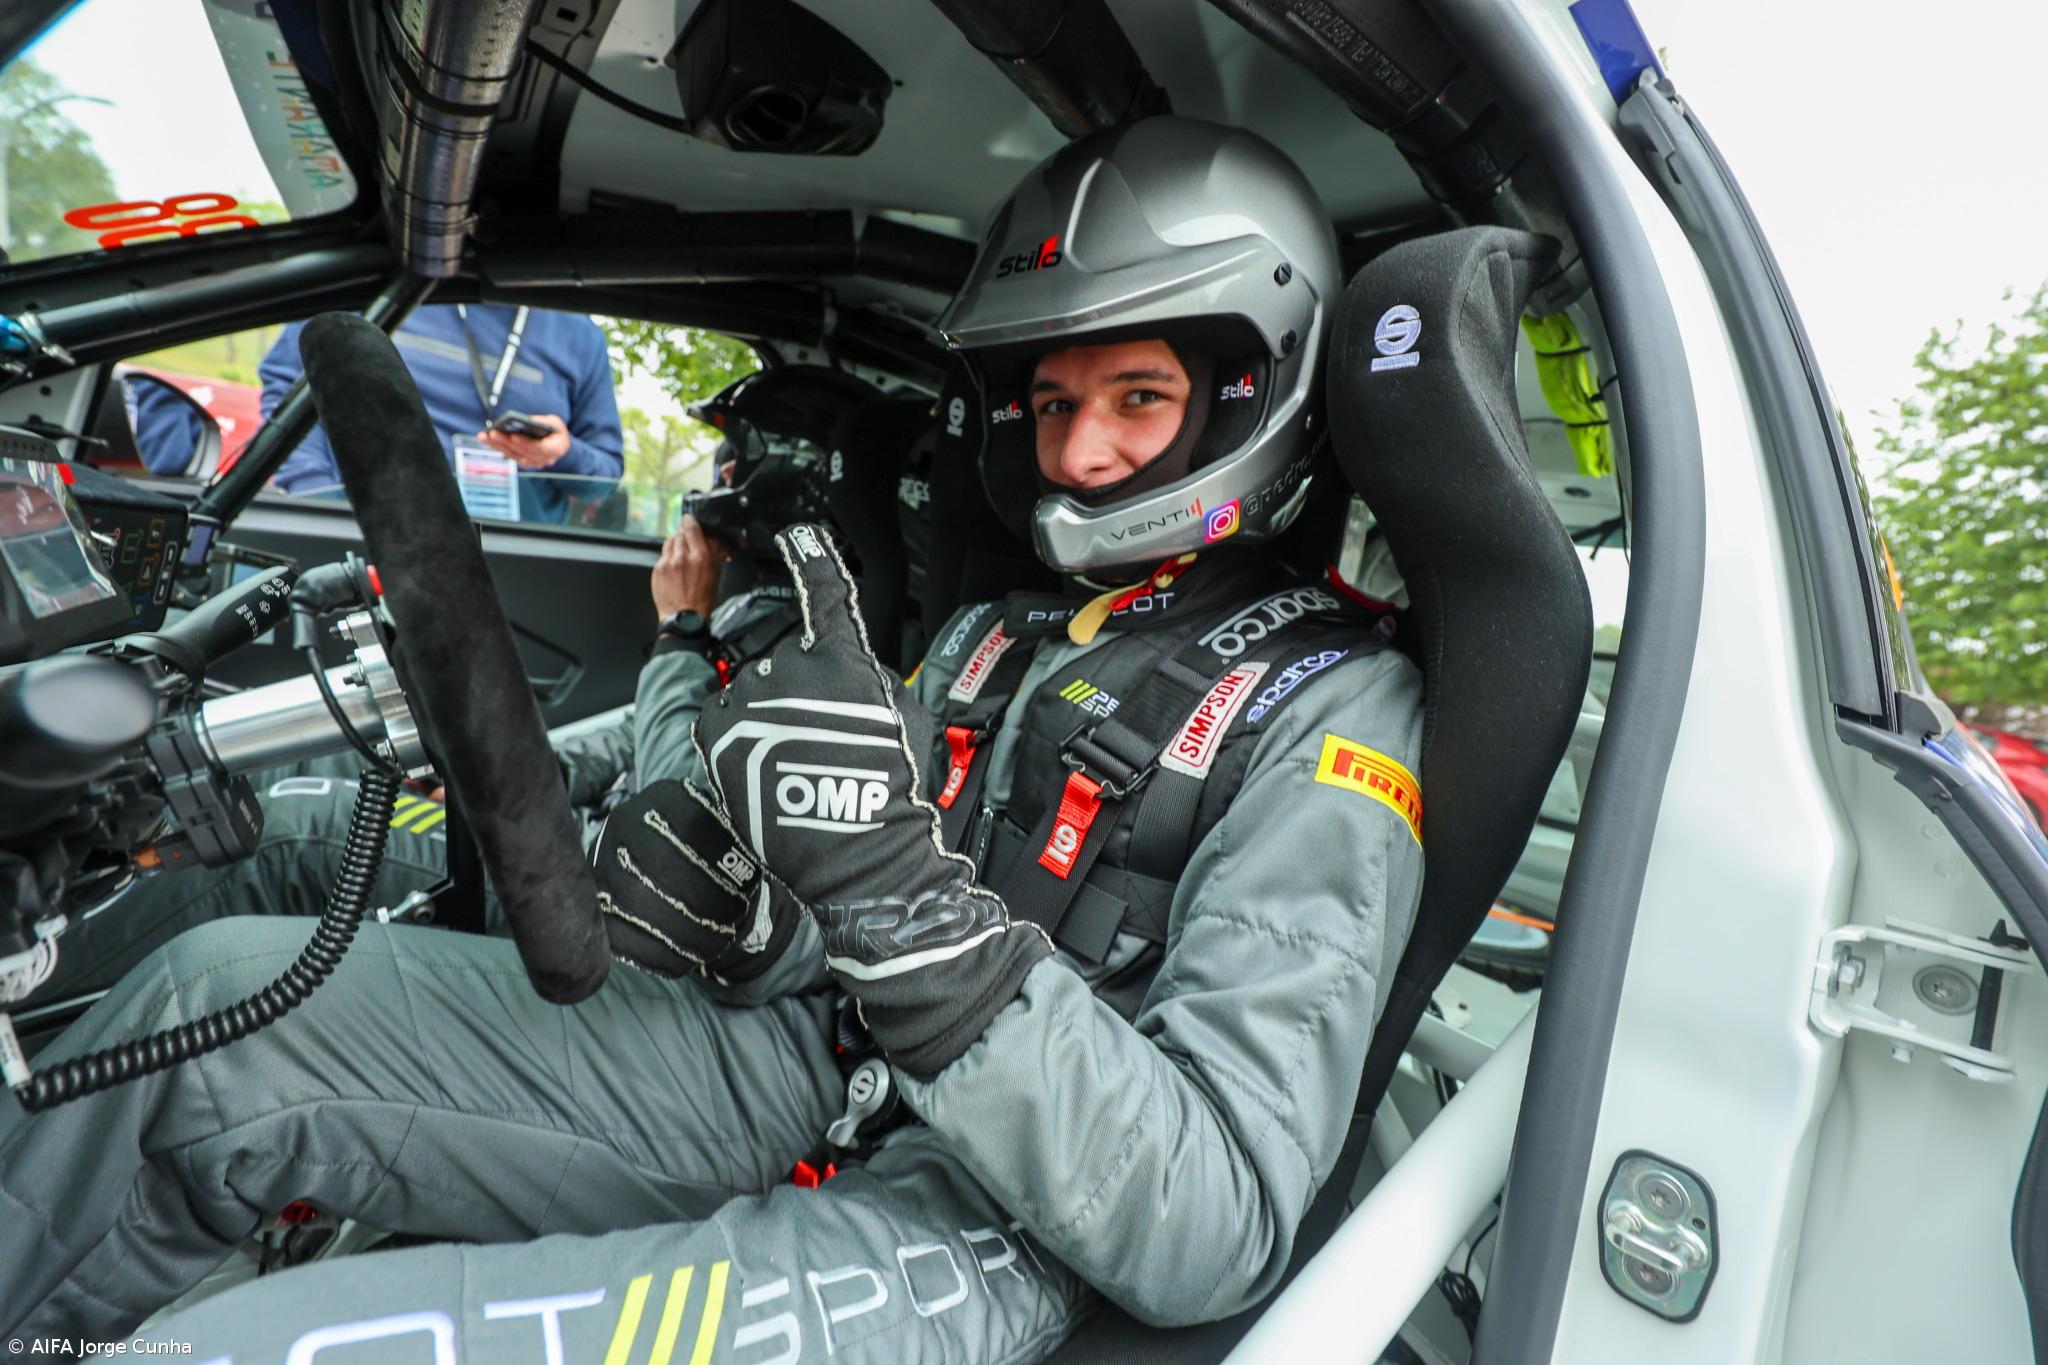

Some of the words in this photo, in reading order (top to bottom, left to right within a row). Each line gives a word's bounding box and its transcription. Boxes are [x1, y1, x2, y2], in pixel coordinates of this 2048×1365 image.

[1027, 592, 1175, 623] PEOT
[1205, 587, 1342, 657] sparco
[1179, 668, 1245, 759] SIMPSON
[1246, 649, 1349, 724] sparco
[776, 773, 890, 823] OMP
[721, 850, 755, 882] OMP
